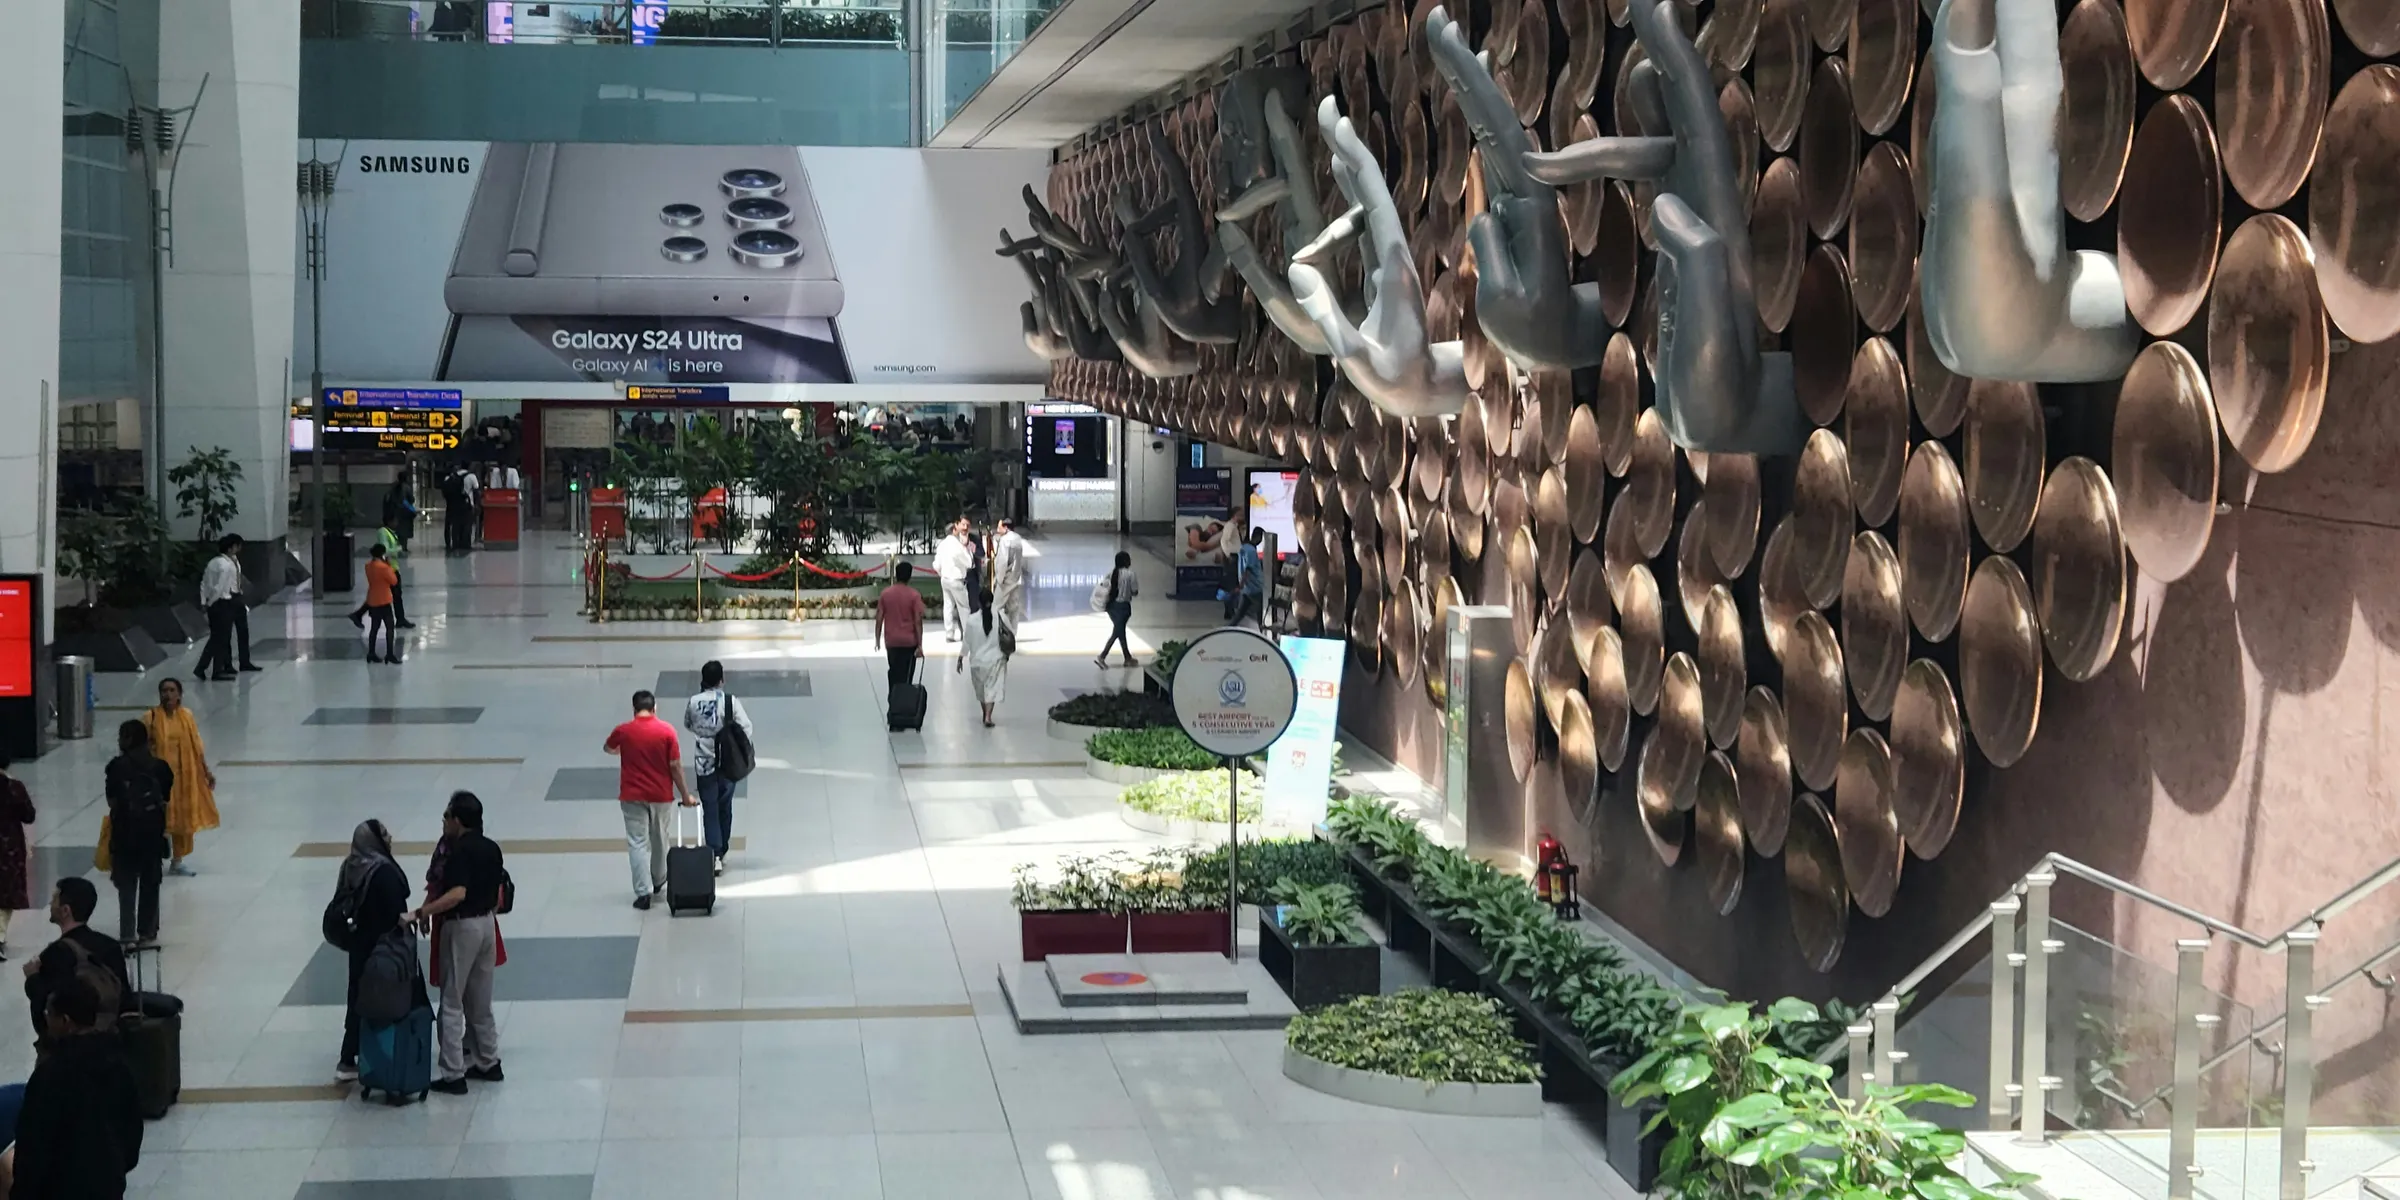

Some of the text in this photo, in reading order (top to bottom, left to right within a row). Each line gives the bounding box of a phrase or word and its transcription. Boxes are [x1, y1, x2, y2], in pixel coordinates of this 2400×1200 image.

[360, 155, 470, 174] SAMSUNG
[552, 330, 743, 354] Galaxy S24 Ultra
[572, 358, 723, 375] Galaxy AI is here
[873, 365, 937, 374] samsung.com
